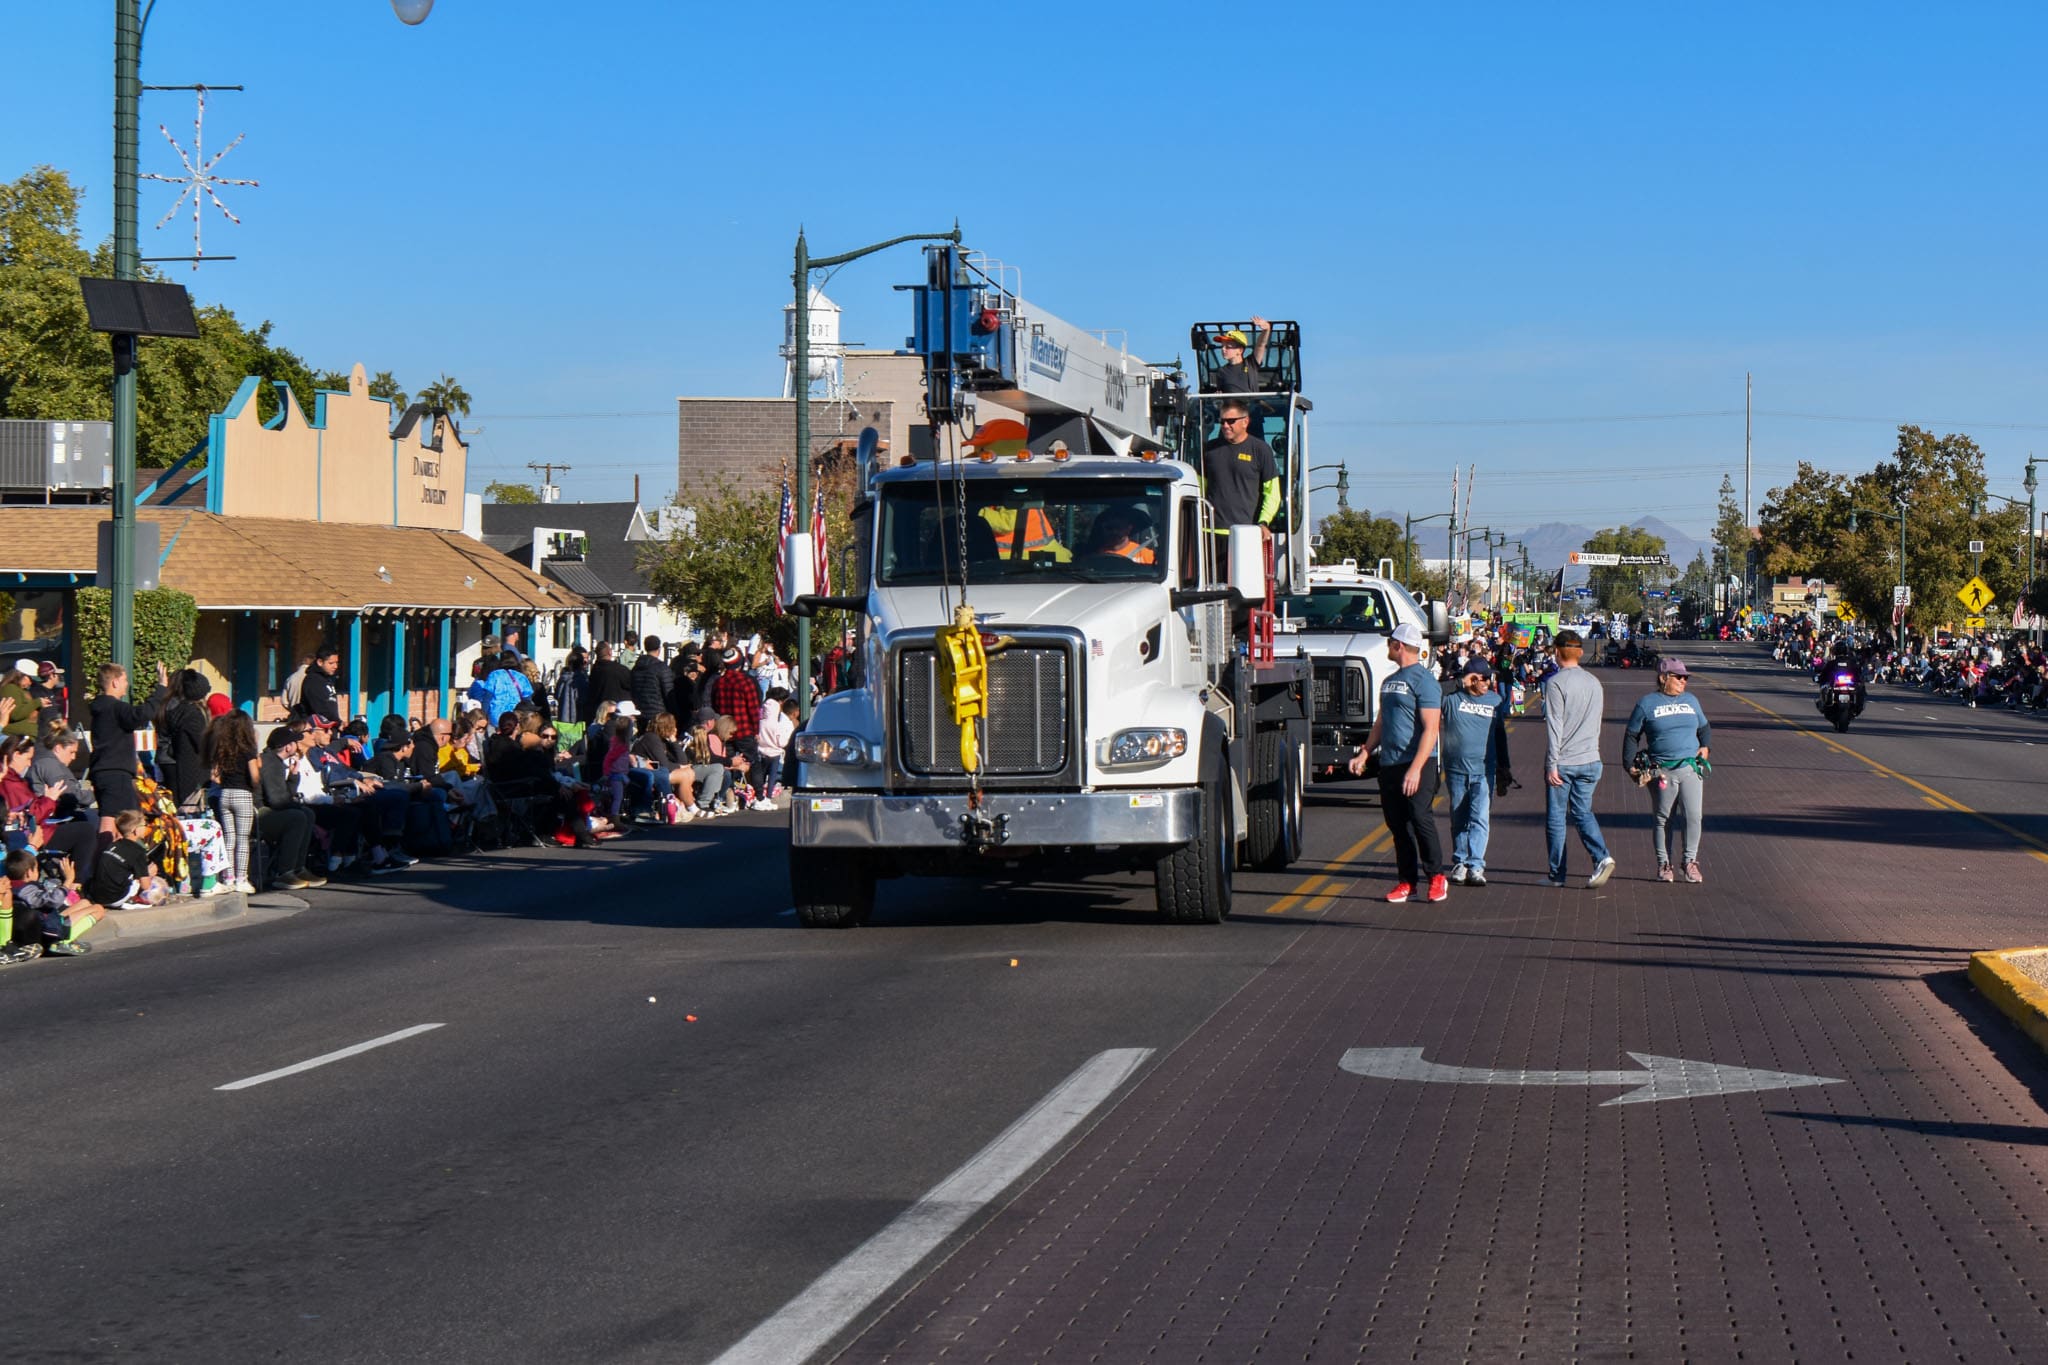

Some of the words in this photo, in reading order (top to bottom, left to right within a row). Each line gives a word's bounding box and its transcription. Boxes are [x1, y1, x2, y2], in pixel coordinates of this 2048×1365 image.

[1030, 334, 1068, 372] Manitex
[421, 484, 447, 504] JEWELRY
[1895, 596, 1909, 604] 25
